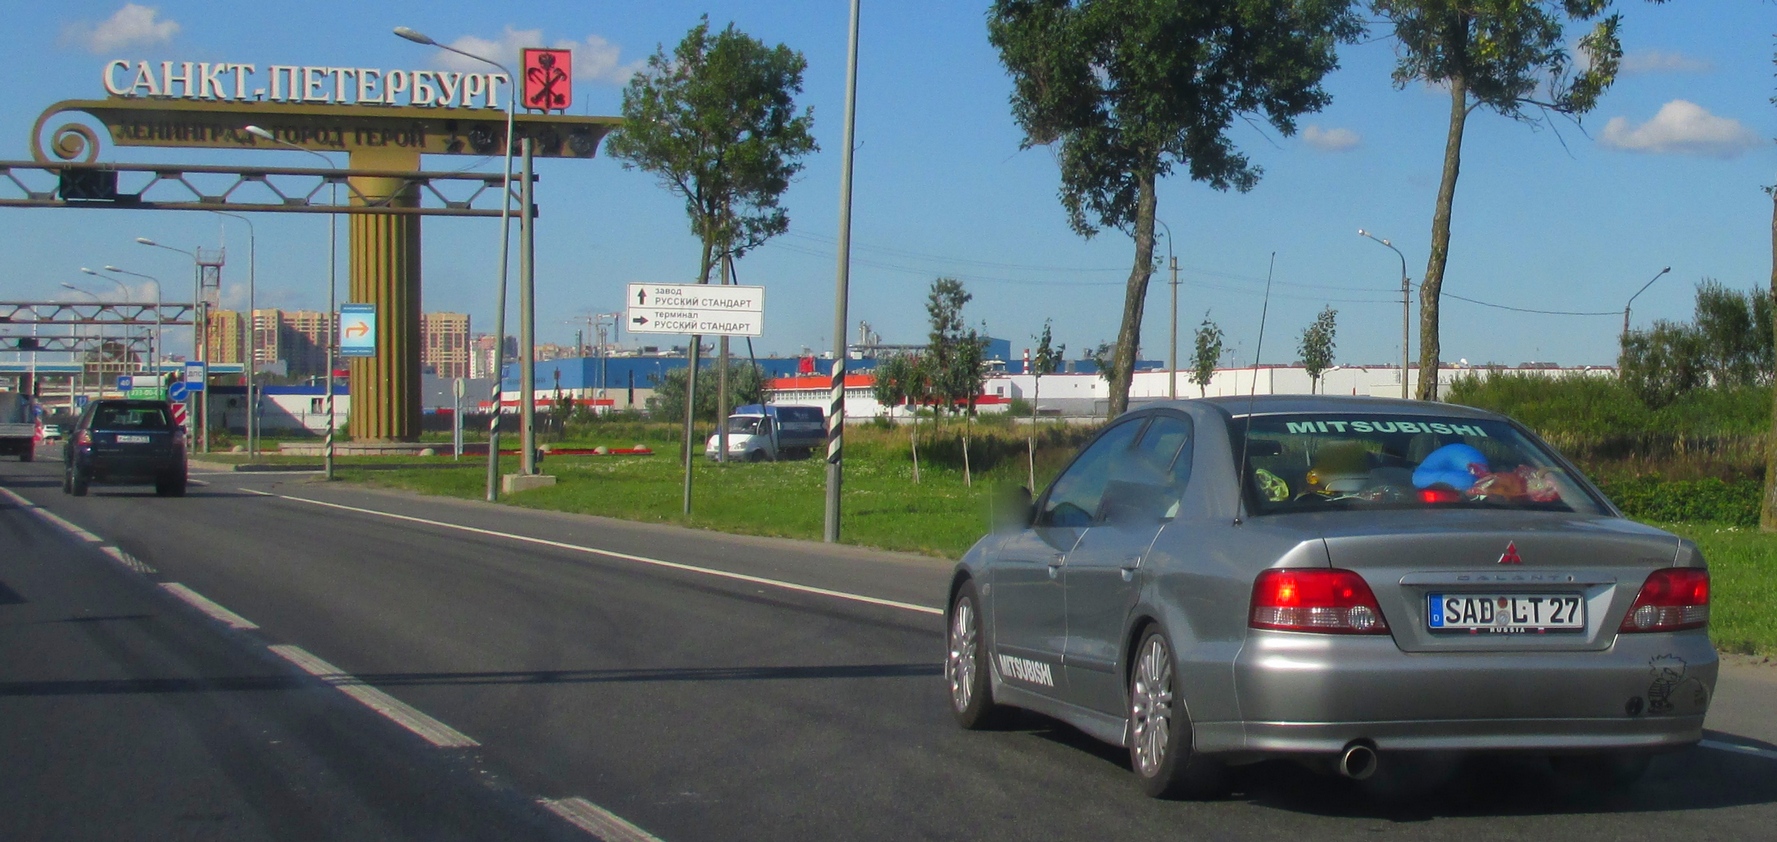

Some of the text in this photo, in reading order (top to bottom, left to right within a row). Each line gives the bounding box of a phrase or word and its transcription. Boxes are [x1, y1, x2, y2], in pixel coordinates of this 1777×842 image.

[104, 59, 510, 106] САНКТ-ПЕТЕРБУРГ
[655, 288, 682, 296] завод
[655, 296, 752, 309] РУССКИЙ СТАНДАРТ
[654, 311, 699, 320] терминал
[654, 320, 751, 332] РУССКИЙ СТАНДАРТ
[1286, 421, 1488, 437] MITSUBISHI
[1445, 597, 1495, 624] SAD
[1511, 597, 1544, 624] LT
[1550, 597, 1580, 624] 27
[999, 654, 1054, 687] MITSUBISHI
